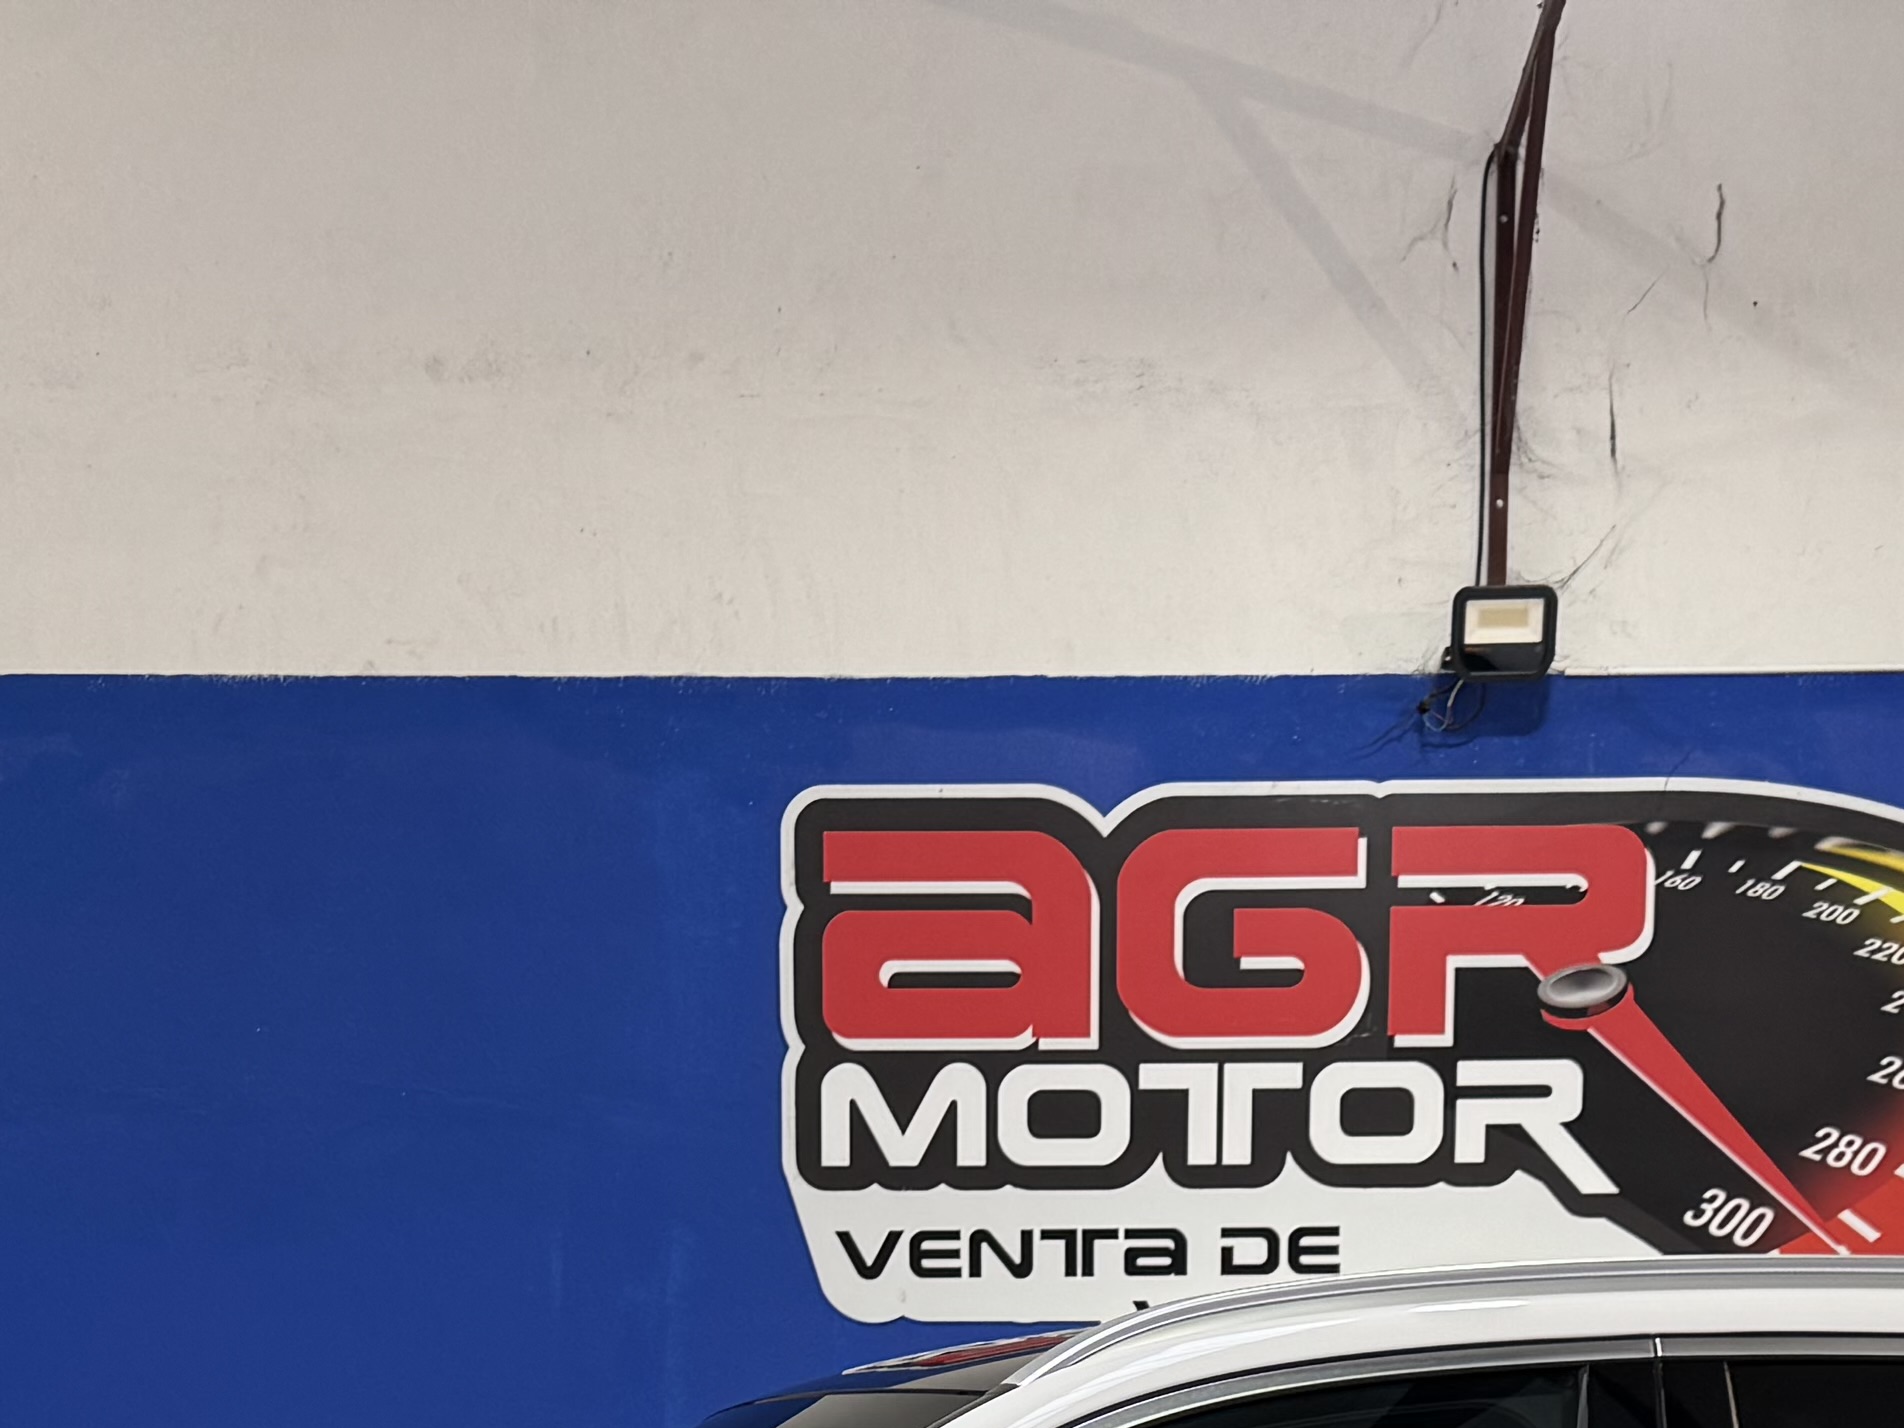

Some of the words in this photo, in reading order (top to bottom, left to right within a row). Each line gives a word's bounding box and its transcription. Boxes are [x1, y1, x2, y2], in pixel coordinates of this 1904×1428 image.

[1654, 869, 1702, 891] 160
[1735, 878, 1786, 901] 180
[1802, 901, 1861, 925] 200
[820, 1060, 1620, 1195] MOTOR
[1798, 1126, 1887, 1177] 280
[1682, 1187, 1775, 1248] 300
[1220, 1226, 1341, 1277] DE
